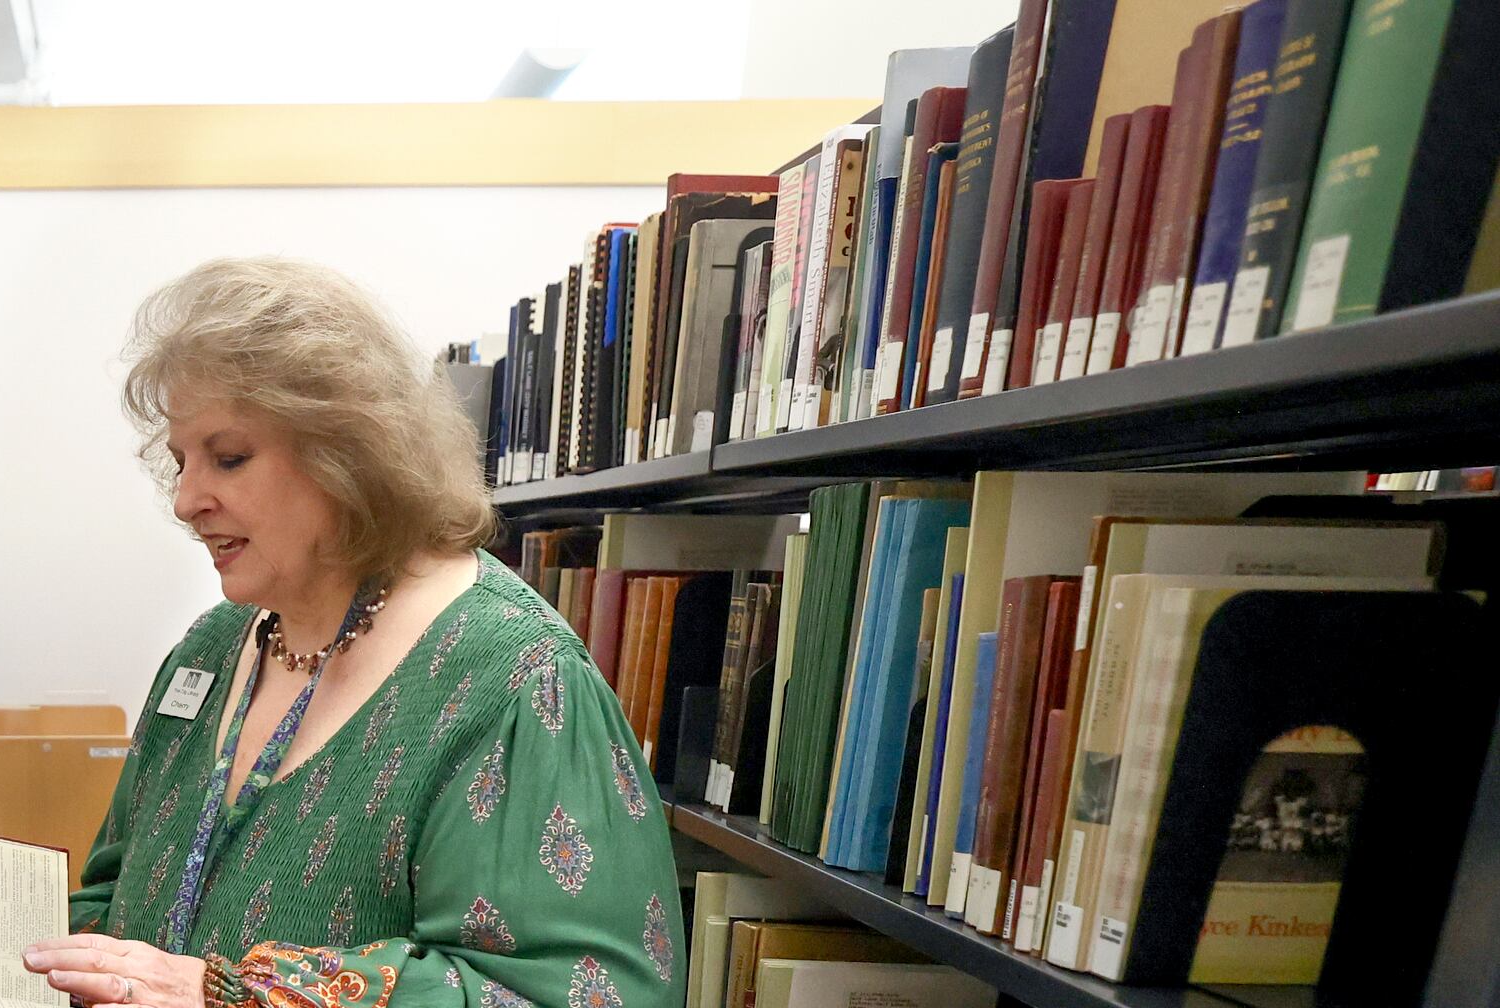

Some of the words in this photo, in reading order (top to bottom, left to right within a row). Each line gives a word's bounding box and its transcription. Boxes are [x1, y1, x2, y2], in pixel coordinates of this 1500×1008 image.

[772, 171, 801, 268] SALAMANDER
[813, 160, 835, 259] Elizabeth
[805, 267, 820, 324] Smart
